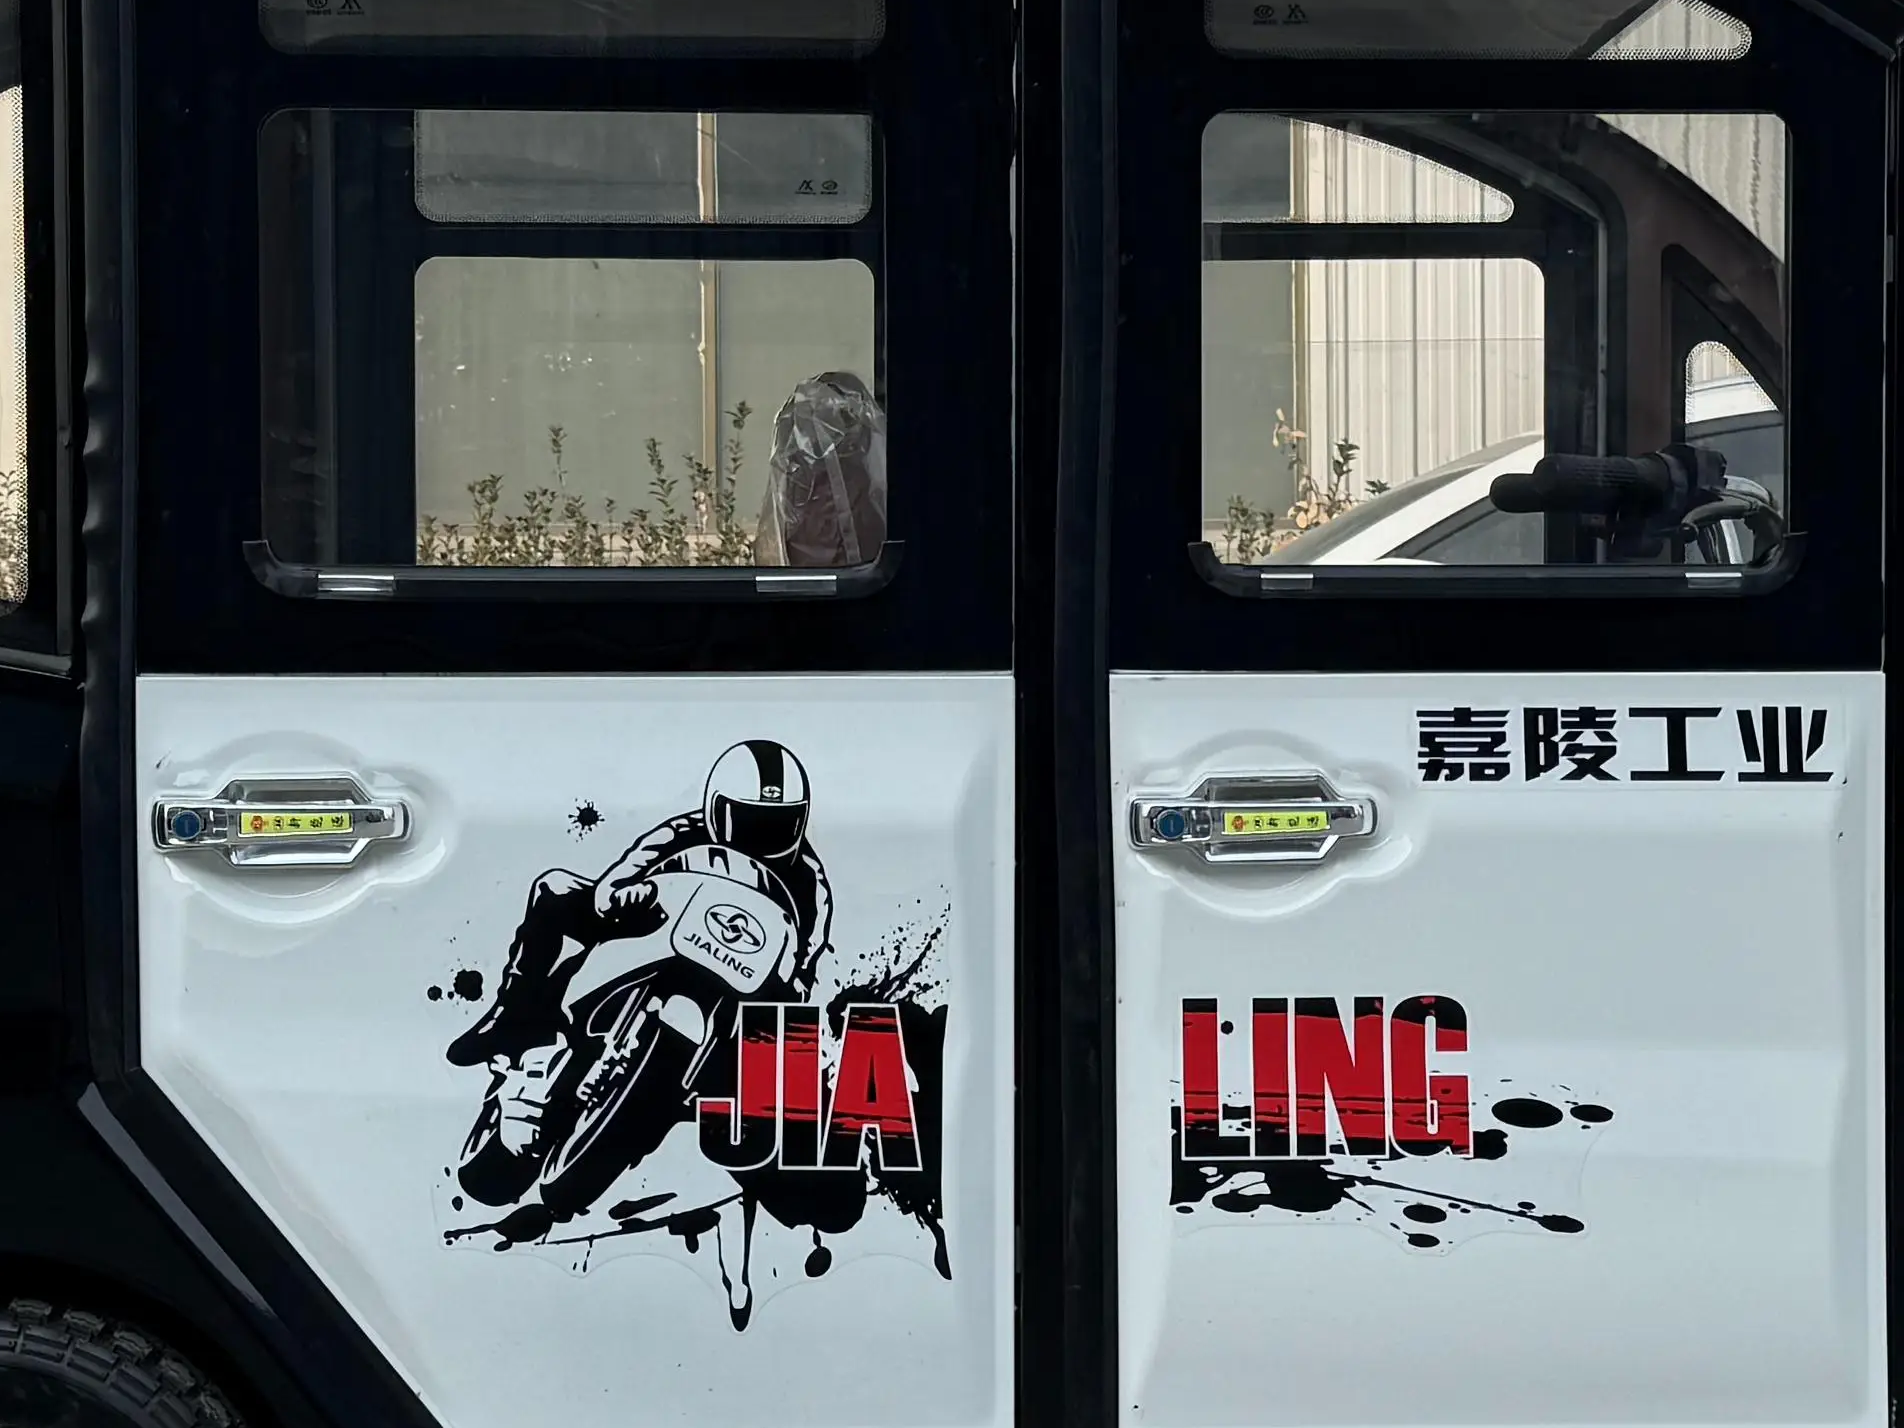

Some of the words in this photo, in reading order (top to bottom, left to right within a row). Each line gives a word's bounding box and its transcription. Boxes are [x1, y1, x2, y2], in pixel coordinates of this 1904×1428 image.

[1416, 706, 1834, 782] 嘉陵工业
[683, 933, 756, 979] JIALING
[696, 1001, 923, 1171] JIA
[1182, 995, 1473, 1159] LING
